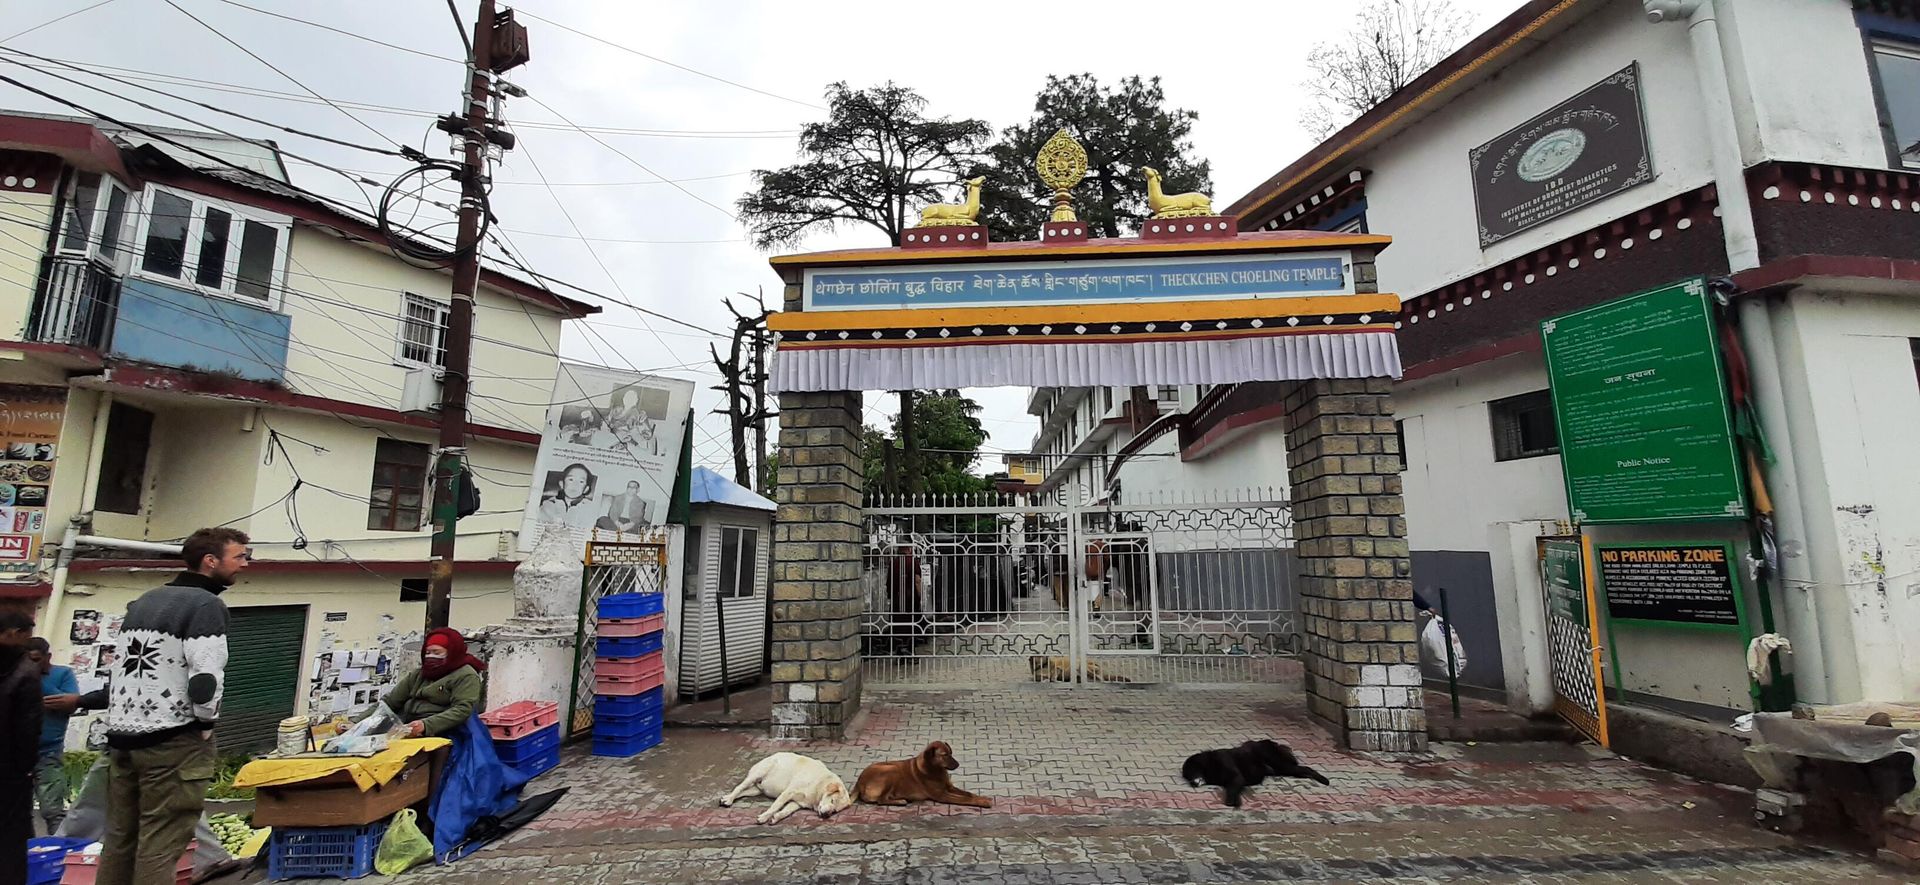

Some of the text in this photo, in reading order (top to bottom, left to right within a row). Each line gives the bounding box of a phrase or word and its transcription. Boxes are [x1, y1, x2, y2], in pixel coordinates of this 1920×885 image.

[1501, 163, 1618, 218] INSTITUTE OF BUDDHIST DIALECTICS
[1160, 267, 1338, 287] THECKCHEN CHOELING TEMPLE
[859, 279, 901, 294] छोलिंग
[904, 281, 926, 297] बुद्ध
[931, 277, 965, 292] विहार
[1603, 368, 1656, 385] जन सूचना
[1617, 456, 1671, 468] Public Notice
[1602, 549, 1725, 562] NO PARKING ZONE
